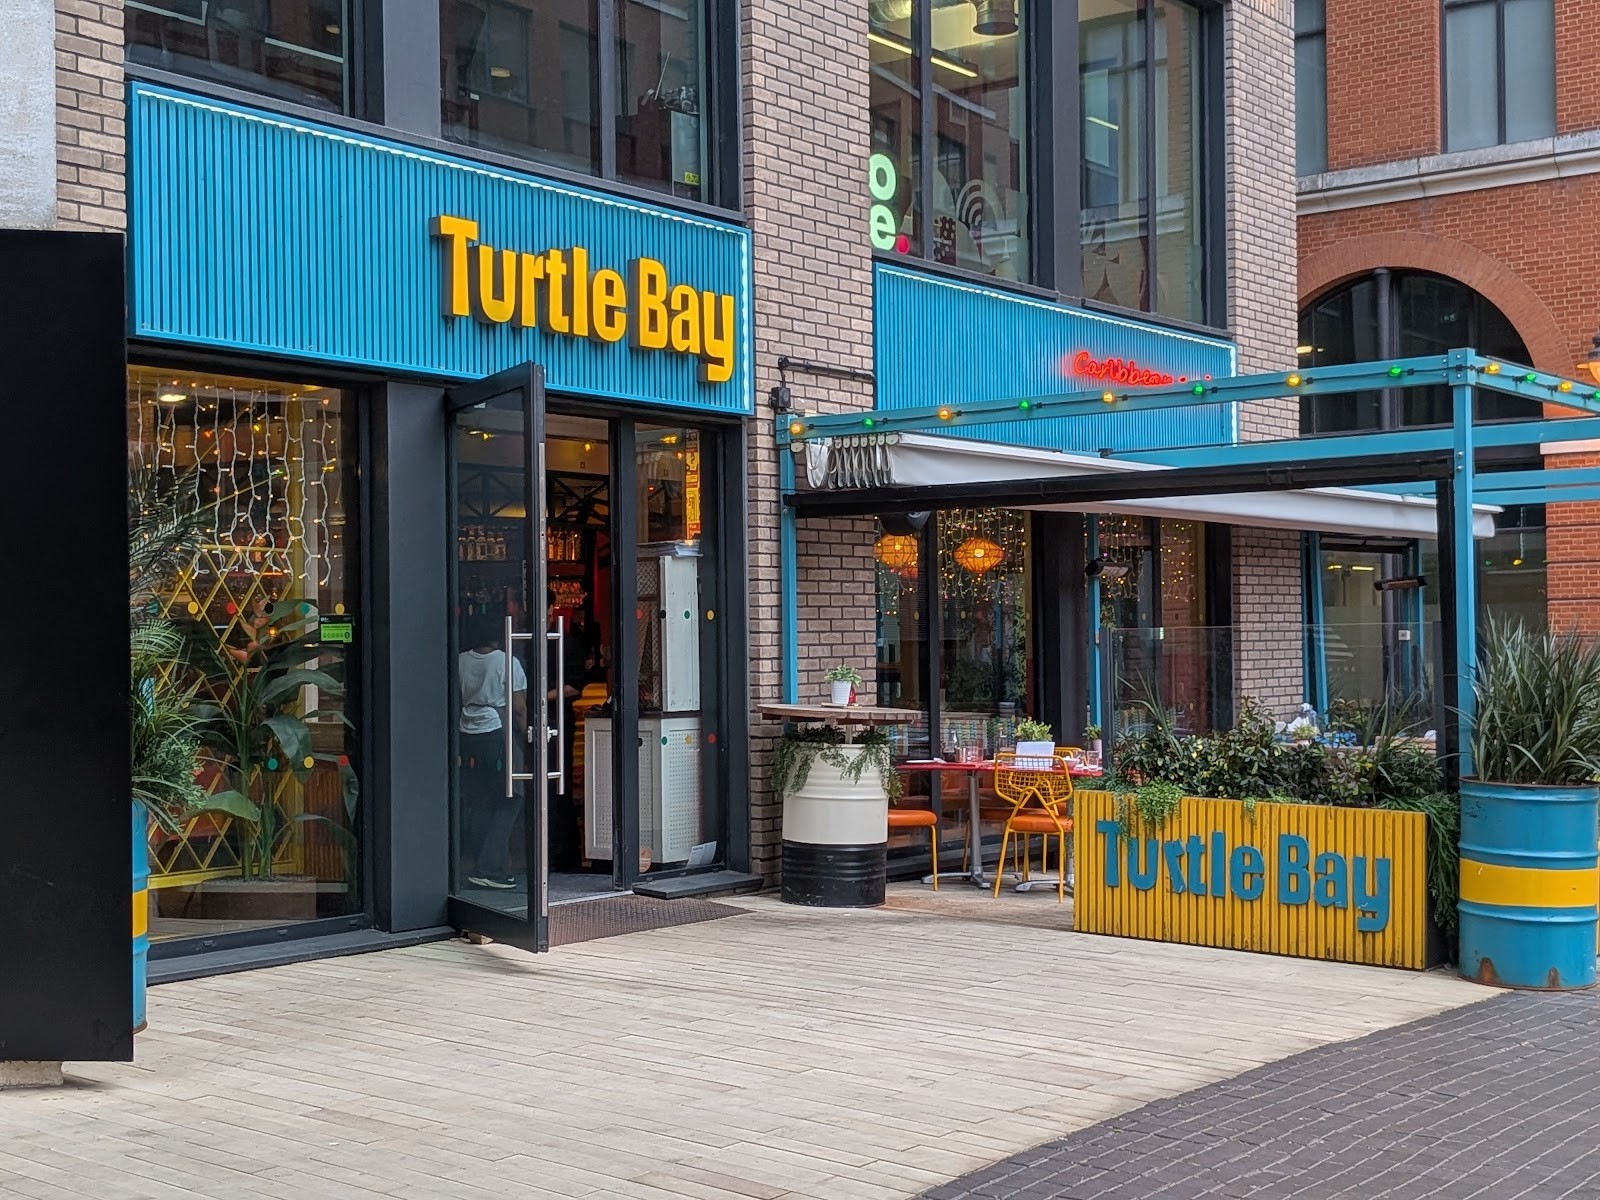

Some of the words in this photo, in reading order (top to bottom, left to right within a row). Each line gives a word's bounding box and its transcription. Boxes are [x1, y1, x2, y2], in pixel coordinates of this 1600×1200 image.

[433, 214, 627, 342] Turtle
[631, 257, 734, 382] Bay
[1096, 819, 1265, 901] Turtle
[1278, 833, 1391, 932] Bay
